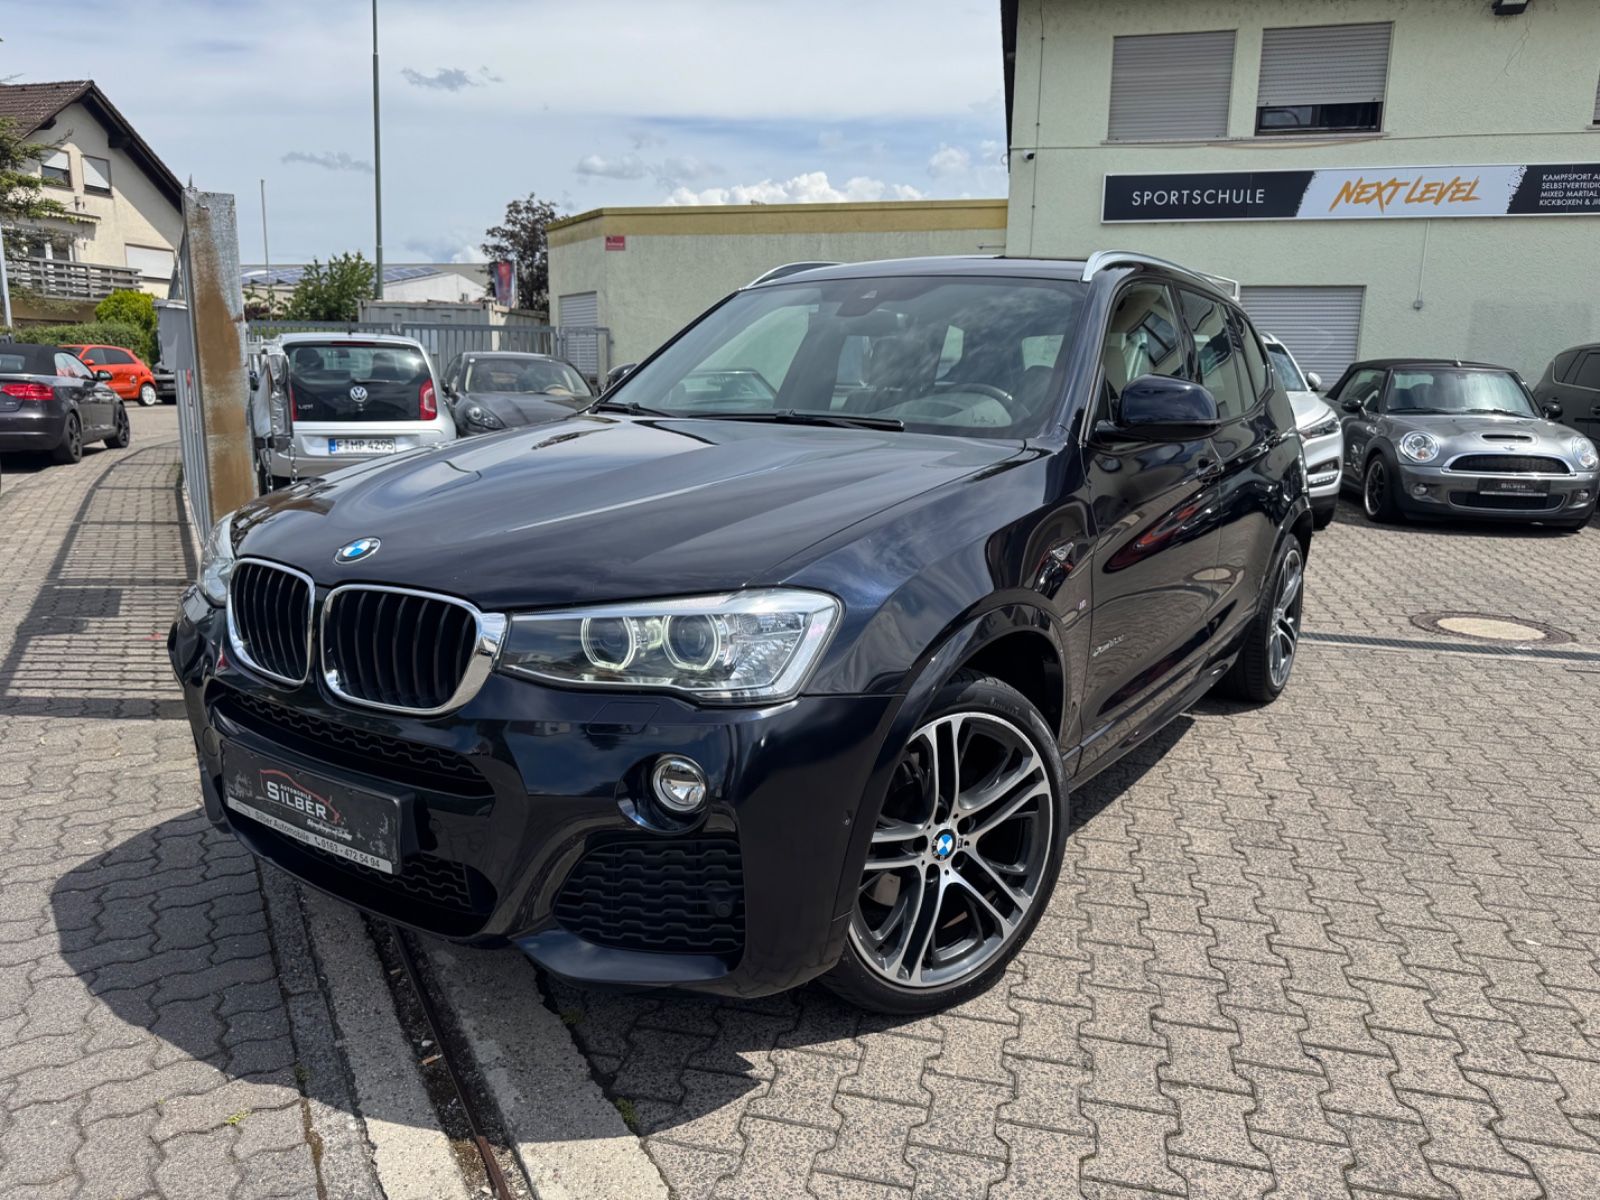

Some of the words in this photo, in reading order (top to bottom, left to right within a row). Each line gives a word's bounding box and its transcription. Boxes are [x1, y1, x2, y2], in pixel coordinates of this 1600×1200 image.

[1542, 173, 1592, 181] KAMPFSPORT
[1132, 188, 1265, 206] SPORTSCHULE
[1328, 177, 1410, 214] NEXT
[1404, 175, 1482, 206] LEVEL
[1540, 190, 1564, 198] MIXED
[1539, 198, 1583, 206] KICKBOXEN
[1584, 198, 1590, 206] &
[267, 781, 327, 820] SILBER
